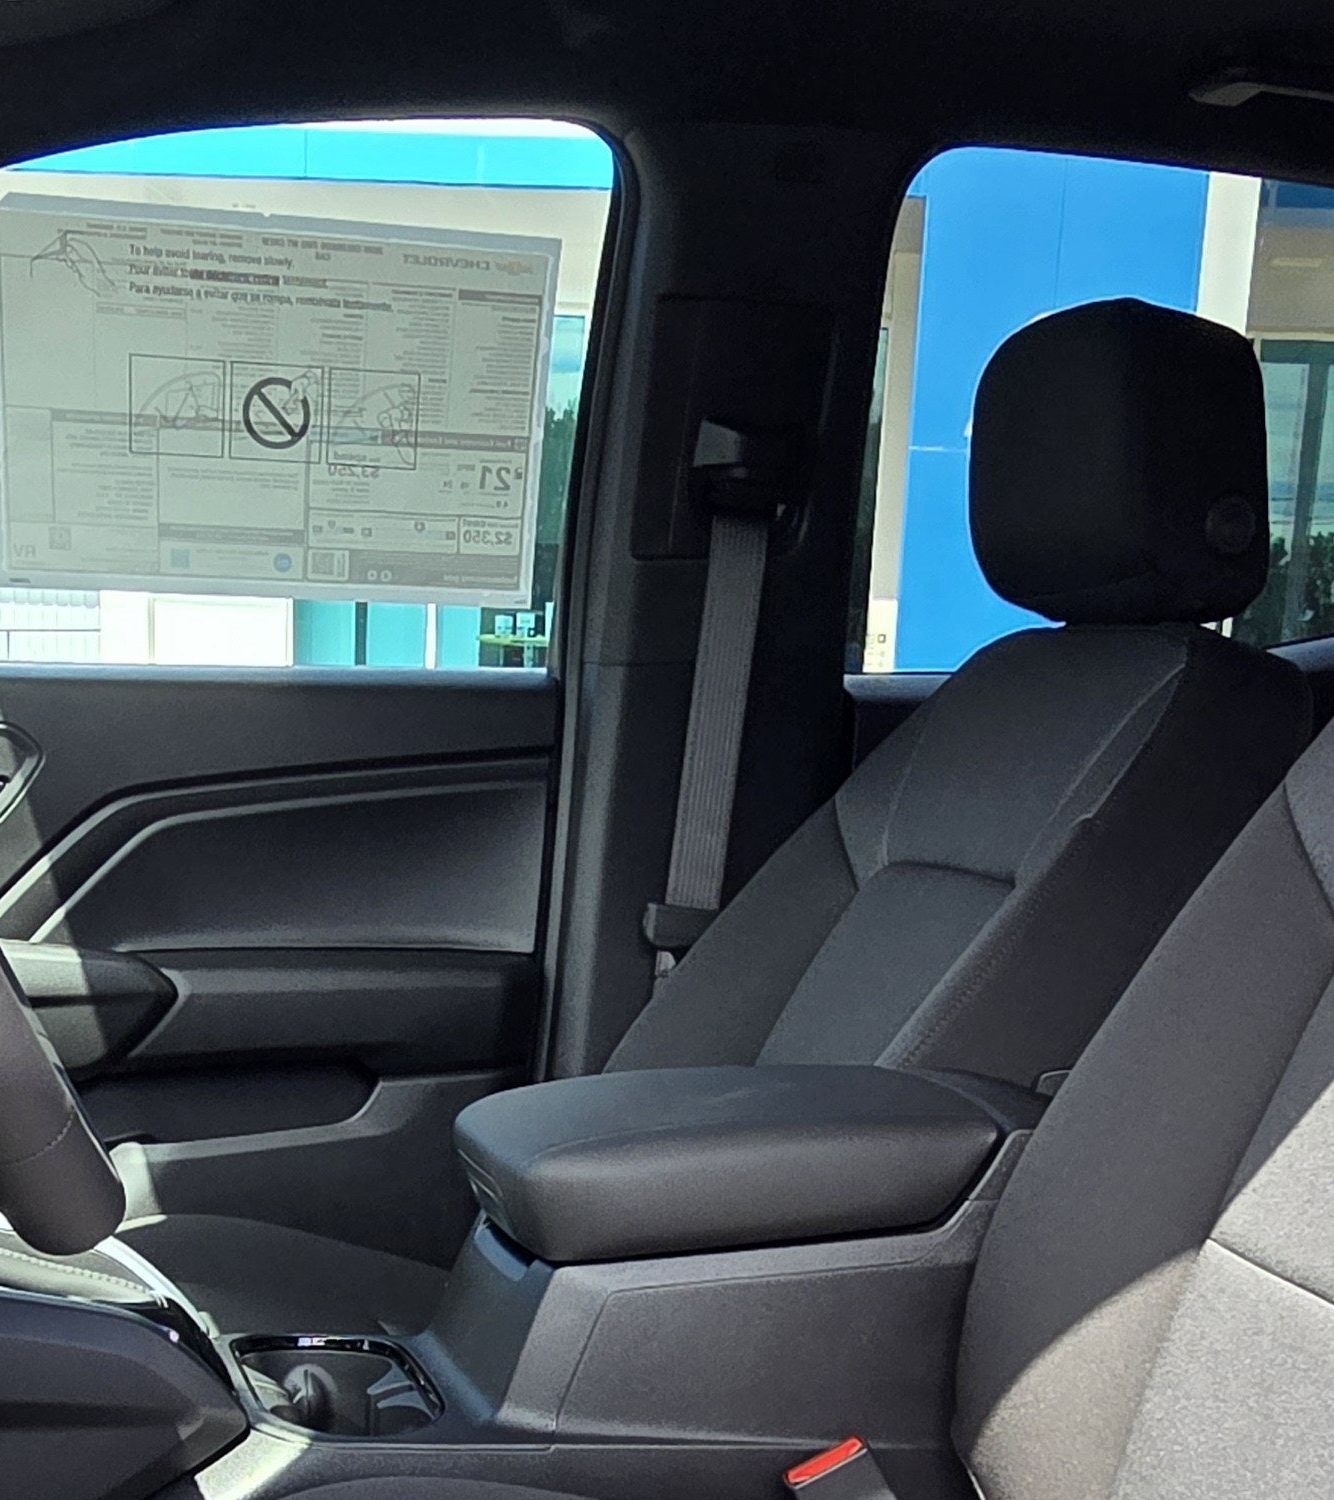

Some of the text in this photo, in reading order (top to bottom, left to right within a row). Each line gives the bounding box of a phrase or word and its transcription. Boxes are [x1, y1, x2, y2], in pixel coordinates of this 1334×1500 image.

[129, 244, 142, 256] To
[143, 246, 163, 258] help
[165, 249, 189, 259] avoid
[229, 255, 261, 265] remove
[129, 282, 150, 294] Para
